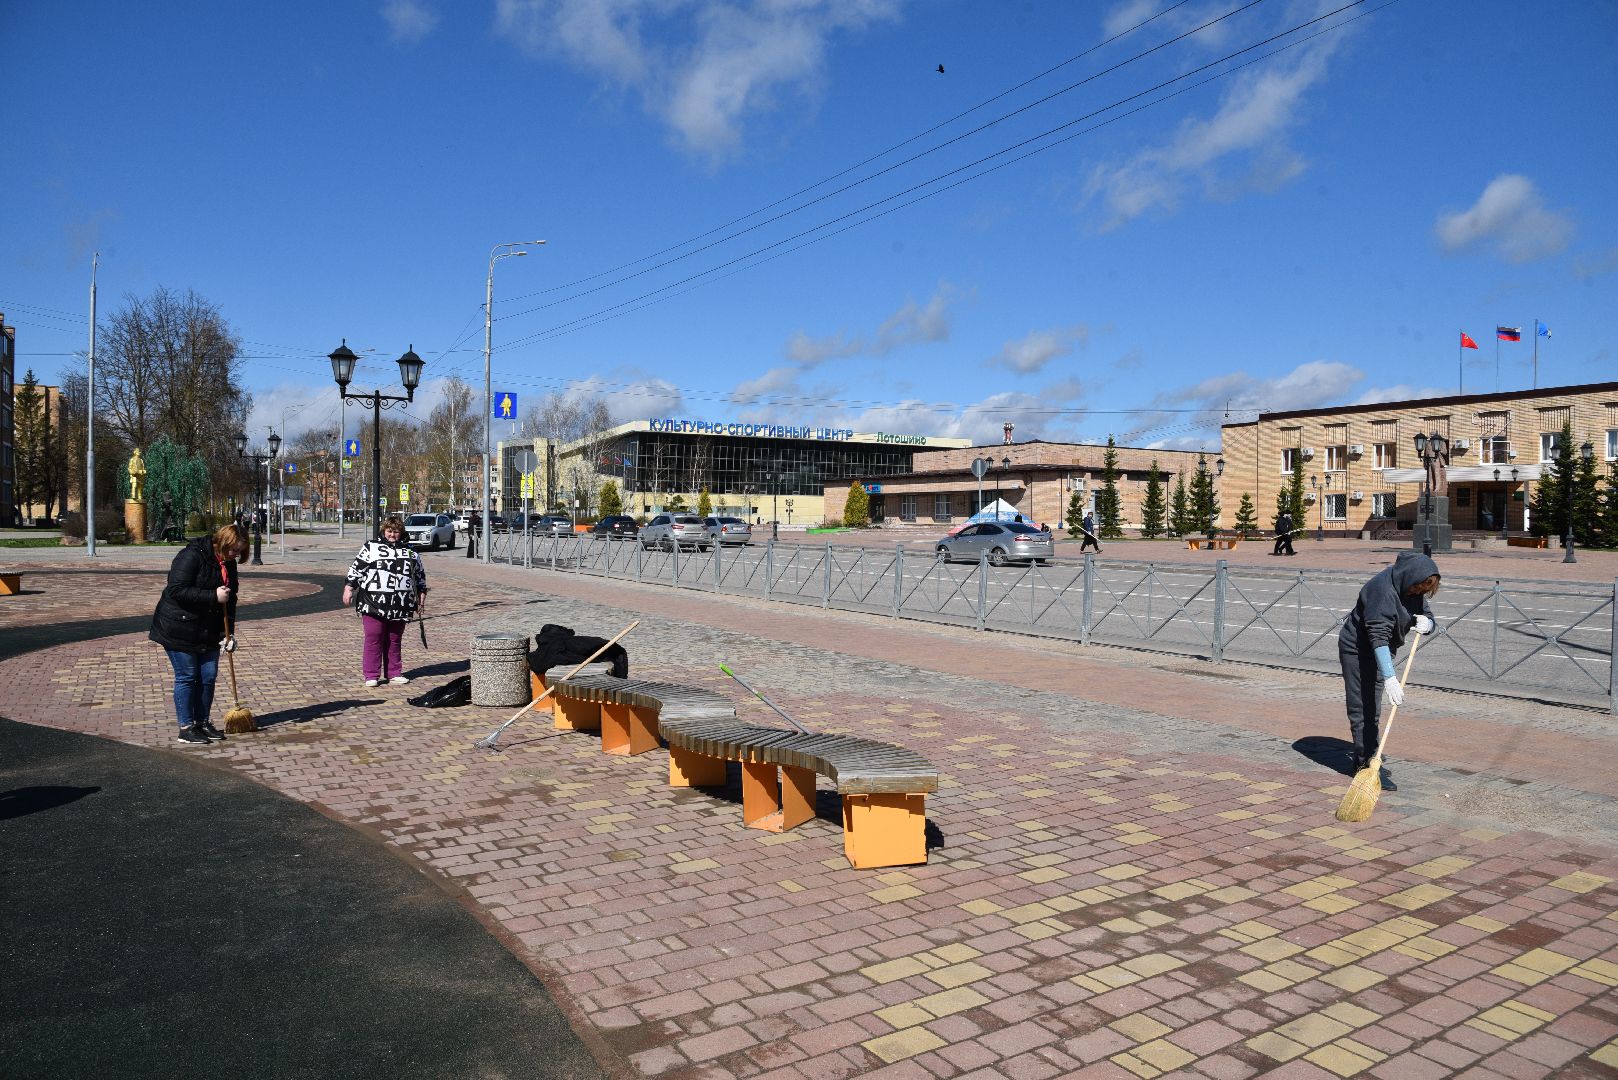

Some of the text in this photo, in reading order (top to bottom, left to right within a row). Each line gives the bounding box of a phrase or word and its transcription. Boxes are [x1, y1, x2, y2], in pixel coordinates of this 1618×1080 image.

[649, 418, 853, 440] КУЛЬТУРНО-СПОРТИВНЫЙ ЦЕНТР
[876, 432, 927, 445] Лотошино
